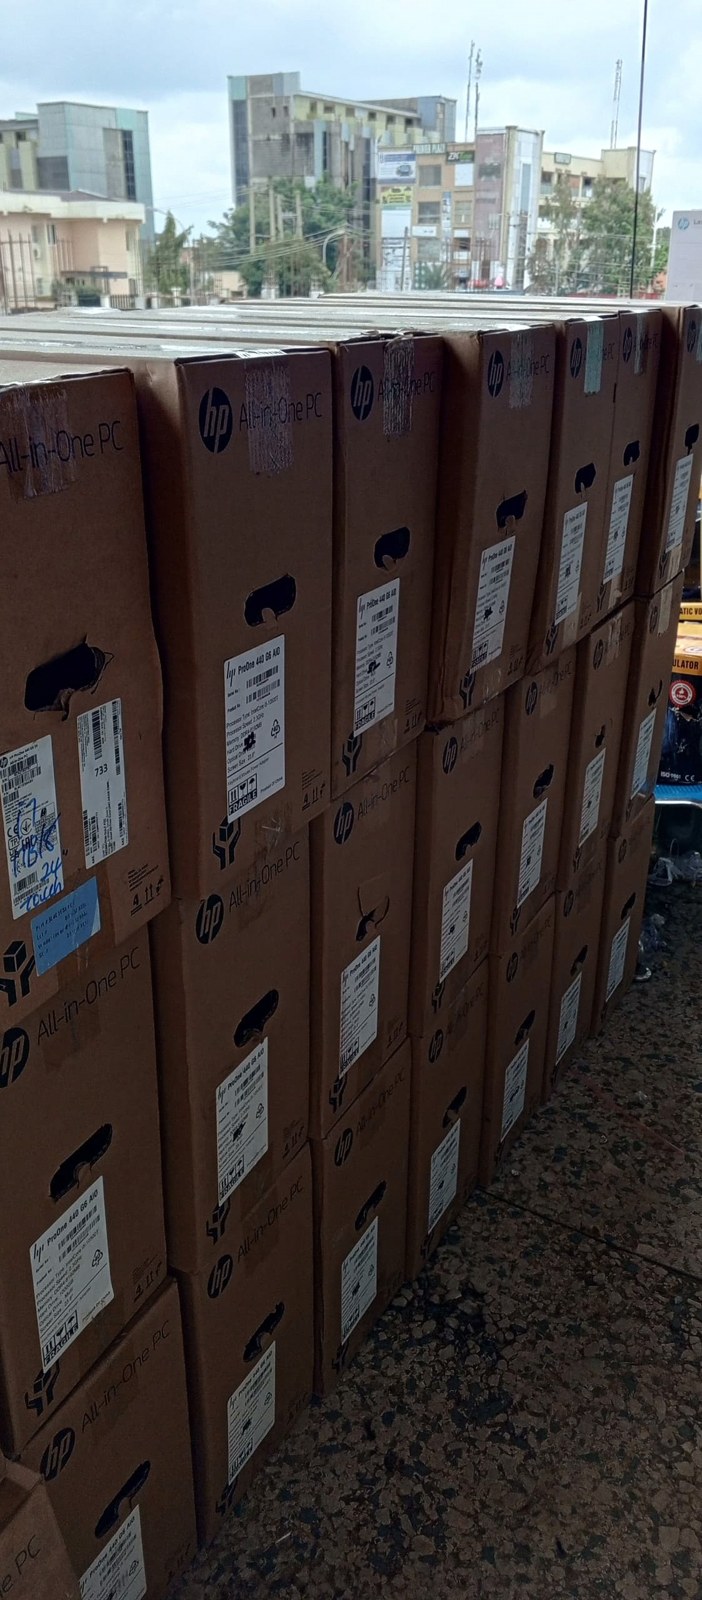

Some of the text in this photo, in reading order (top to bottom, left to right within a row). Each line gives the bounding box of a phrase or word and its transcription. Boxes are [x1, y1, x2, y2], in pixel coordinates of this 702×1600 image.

[570, 337, 582, 379] hp
[622, 327, 632, 363] hp
[350, 365, 374, 421] hp
[423, 371, 436, 394] PC
[487, 350, 504, 398] hp
[198, 386, 233, 454] hp
[306, 392, 322, 418] PC
[98, 420, 123, 454] PC
[238, 661, 254, 675] ProOne
[256, 654, 264, 666] 440
[94, 764, 108, 778] 733
[442, 736, 458, 774] hp
[229, 790, 257, 816] FRAGILE
[357, 778, 398, 821] All-in-One
[398, 766, 410, 789] PC
[334, 802, 354, 844] hp
[229, 841, 301, 912] All-in-One PC
[196, 894, 224, 944] hp
[37, 946, 140, 1046] All-in-One PC
[334, 1128, 353, 1166] hp
[47, 1222, 67, 1246] ProOne
[69, 1209, 79, 1223] 440
[238, 1176, 304, 1264] All-in-One PC
[207, 1254, 233, 1298] hp
[82, 1320, 170, 1433] All-in-One PC
[40, 1428, 75, 1482] hp
[14, 1534, 41, 1575] PC
